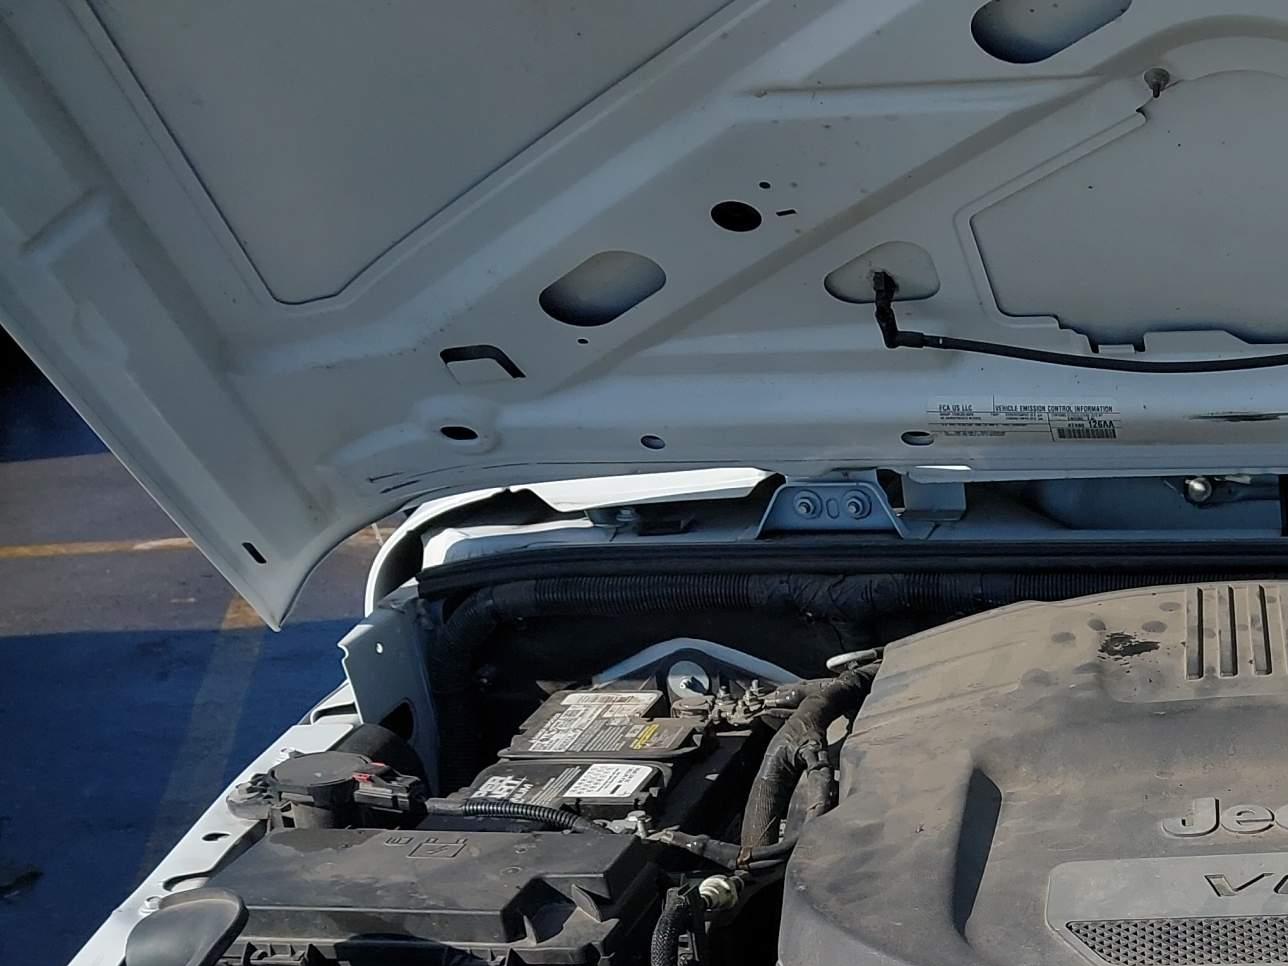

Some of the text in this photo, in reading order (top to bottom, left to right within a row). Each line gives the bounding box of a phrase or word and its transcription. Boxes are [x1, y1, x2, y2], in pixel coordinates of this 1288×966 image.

[939, 404, 973, 412] FCA US LLC
[995, 404, 1018, 412] VEHICLE
[1020, 404, 1046, 412] EMISSION
